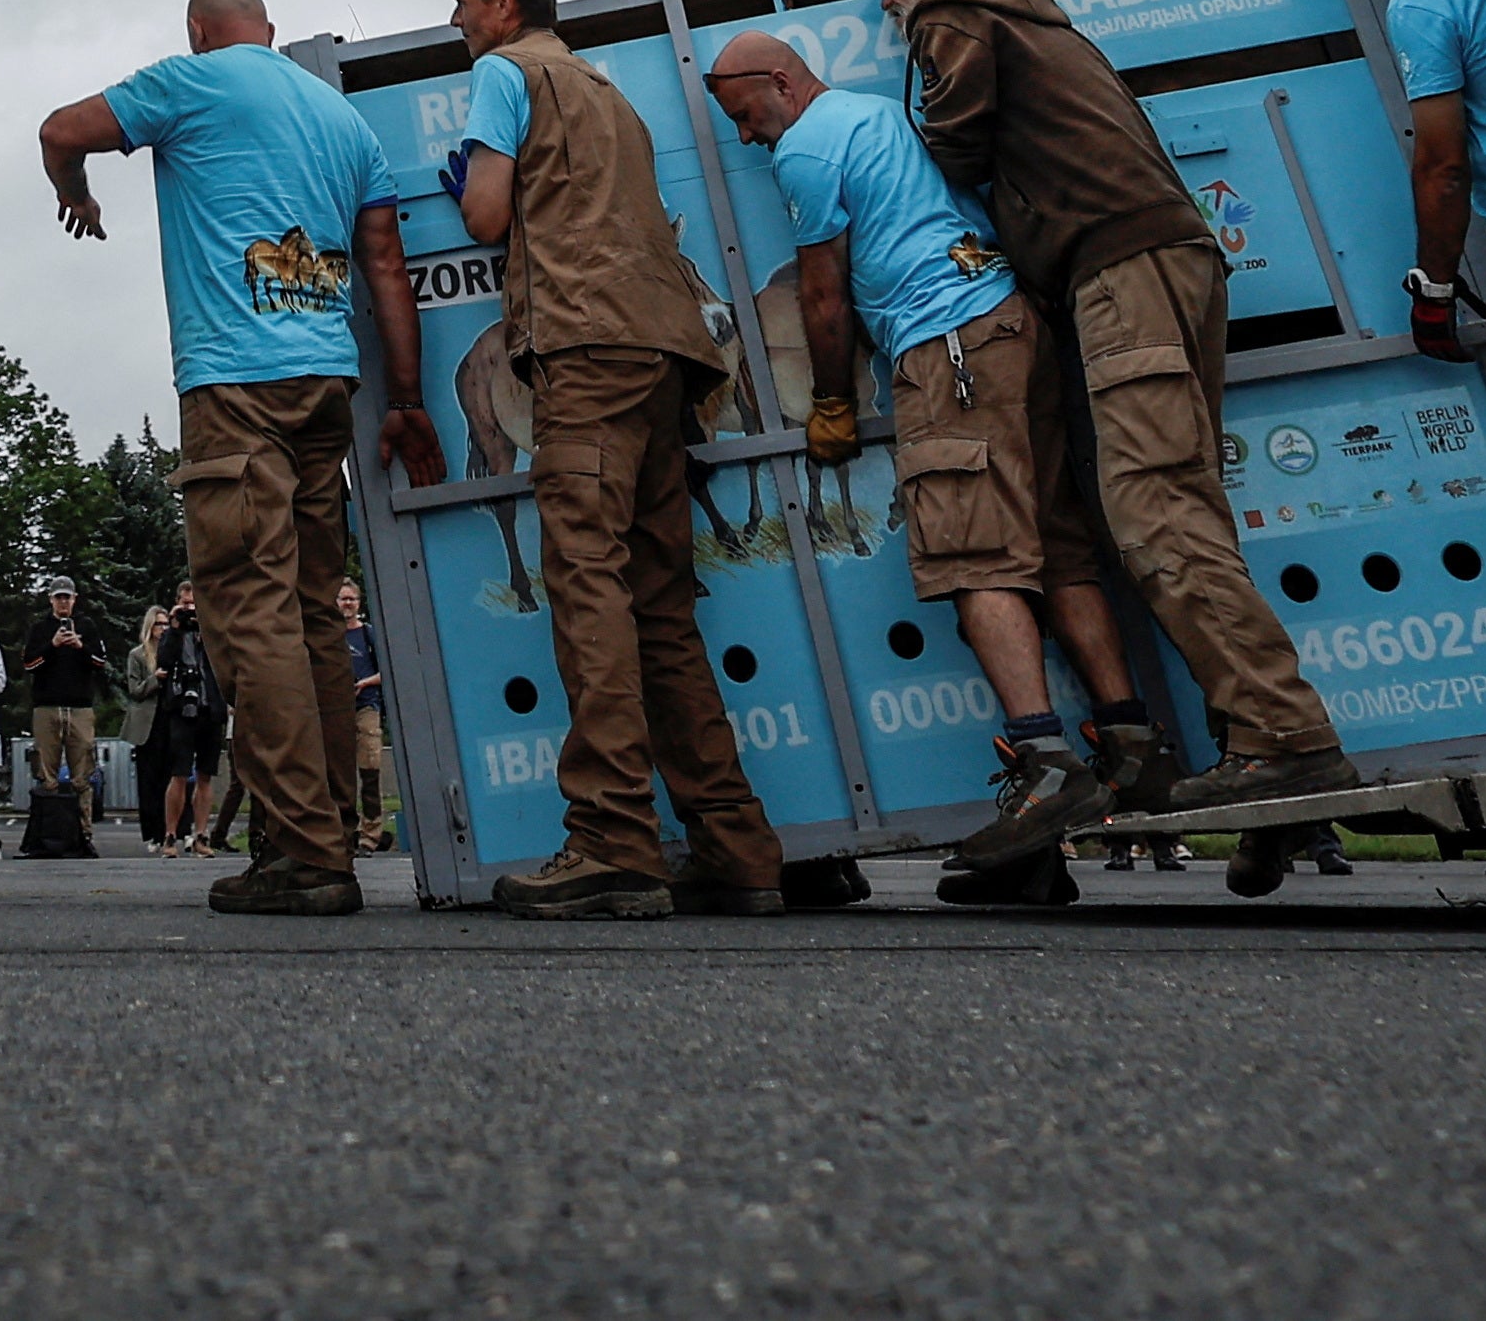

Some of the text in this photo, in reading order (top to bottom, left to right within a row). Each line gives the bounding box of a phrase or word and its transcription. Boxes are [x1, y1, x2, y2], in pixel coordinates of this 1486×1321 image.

[1416, 405, 1469, 424] BERLIN
[1421, 418, 1475, 439] WORLD
[1341, 441, 1393, 457] TIERPARK
[486, 735, 565, 786] IBA
